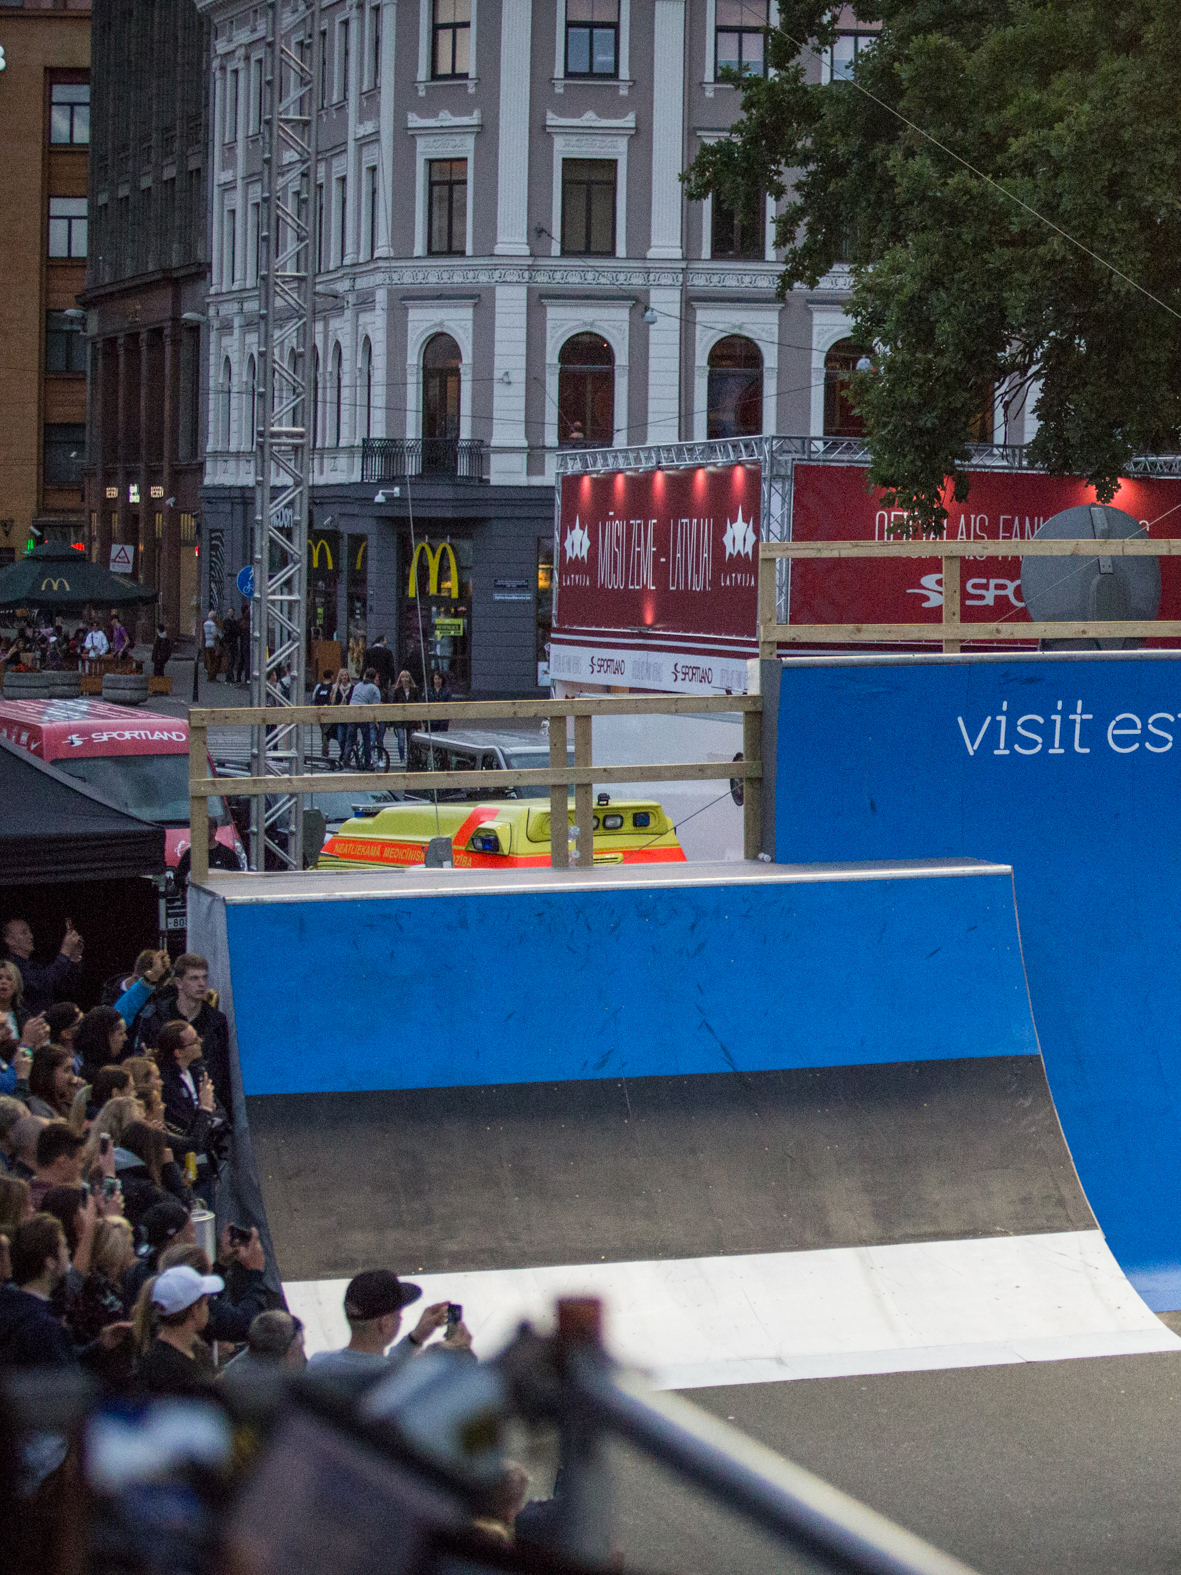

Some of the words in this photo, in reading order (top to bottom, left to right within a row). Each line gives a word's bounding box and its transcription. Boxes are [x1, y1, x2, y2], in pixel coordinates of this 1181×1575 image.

[598, 511, 626, 590] MŪSU
[628, 519, 657, 590] ZEME
[669, 518, 713, 591] LATVIJA!
[563, 575, 590, 586] LATVIJA
[721, 573, 755, 587] LATVIJA
[596, 658, 626, 676] SPORTLAND
[680, 665, 713, 685] SPORTLAND
[91, 730, 187, 743] SPORTLAND
[957, 700, 1094, 756] visit
